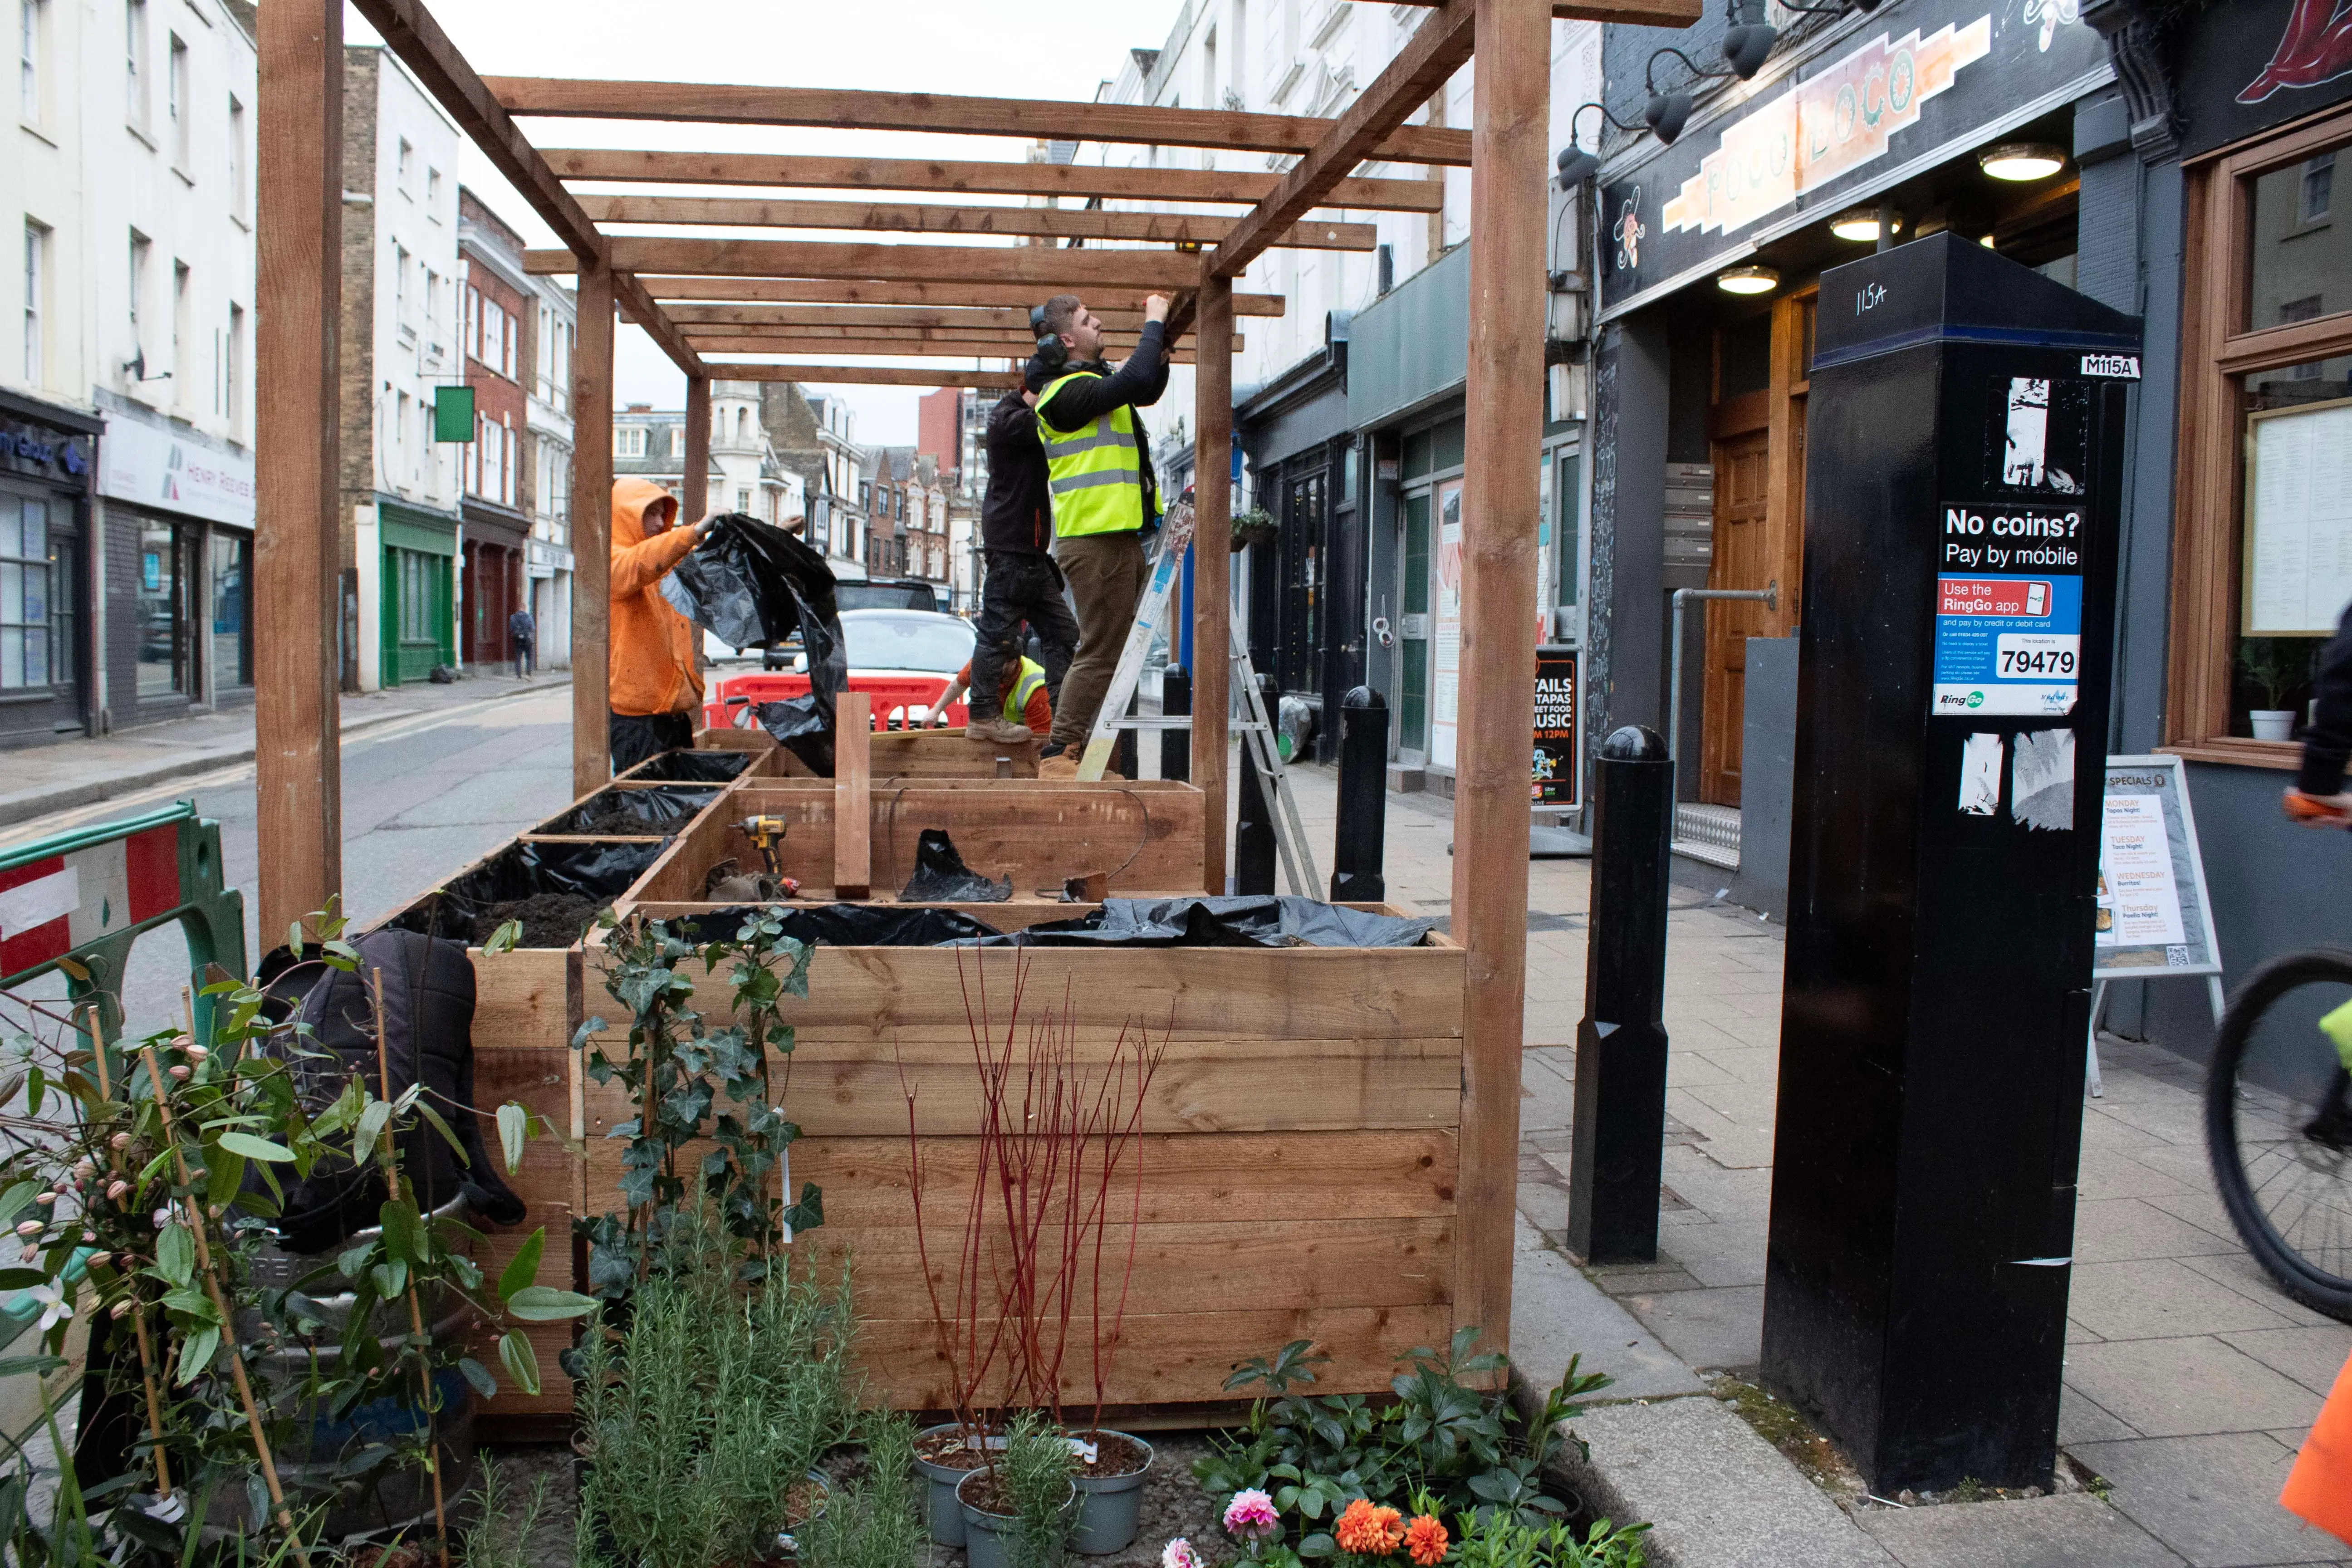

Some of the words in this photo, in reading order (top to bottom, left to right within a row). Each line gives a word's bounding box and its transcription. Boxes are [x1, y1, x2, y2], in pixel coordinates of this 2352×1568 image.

[1706, 130, 1788, 217] POCO
[1809, 49, 1914, 163] LOCO
[1856, 283, 1887, 316] 115A
[2086, 358, 2132, 375] M115A
[1596, 442, 1616, 478] 1995
[1946, 509, 1984, 534] No
[1992, 512, 2080, 538] coins?
[1946, 544, 1982, 567] Pay
[1988, 545, 2010, 568] by
[2016, 546, 2078, 565] mobile
[1945, 583, 1969, 595] Use
[1972, 583, 1991, 596] the
[1944, 598, 1992, 613] RingGo
[1995, 602, 2019, 614] app
[1974, 619, 1982, 627] by
[2002, 650, 2075, 673] 79479
[1534, 678, 1572, 693] AILS
[1535, 694, 1571, 704] TAPAS
[1940, 694, 1983, 706] RingGo
[1534, 705, 1548, 713] EET
[1549, 705, 1572, 713] FOOD
[1544, 730, 1569, 739] 12PM
[2110, 776, 2152, 786] SPECIALS
[2110, 835, 2145, 843] TUESDAY
[2117, 872, 2165, 880] WEDNESDAY
[2122, 904, 2158, 913] Thursday
